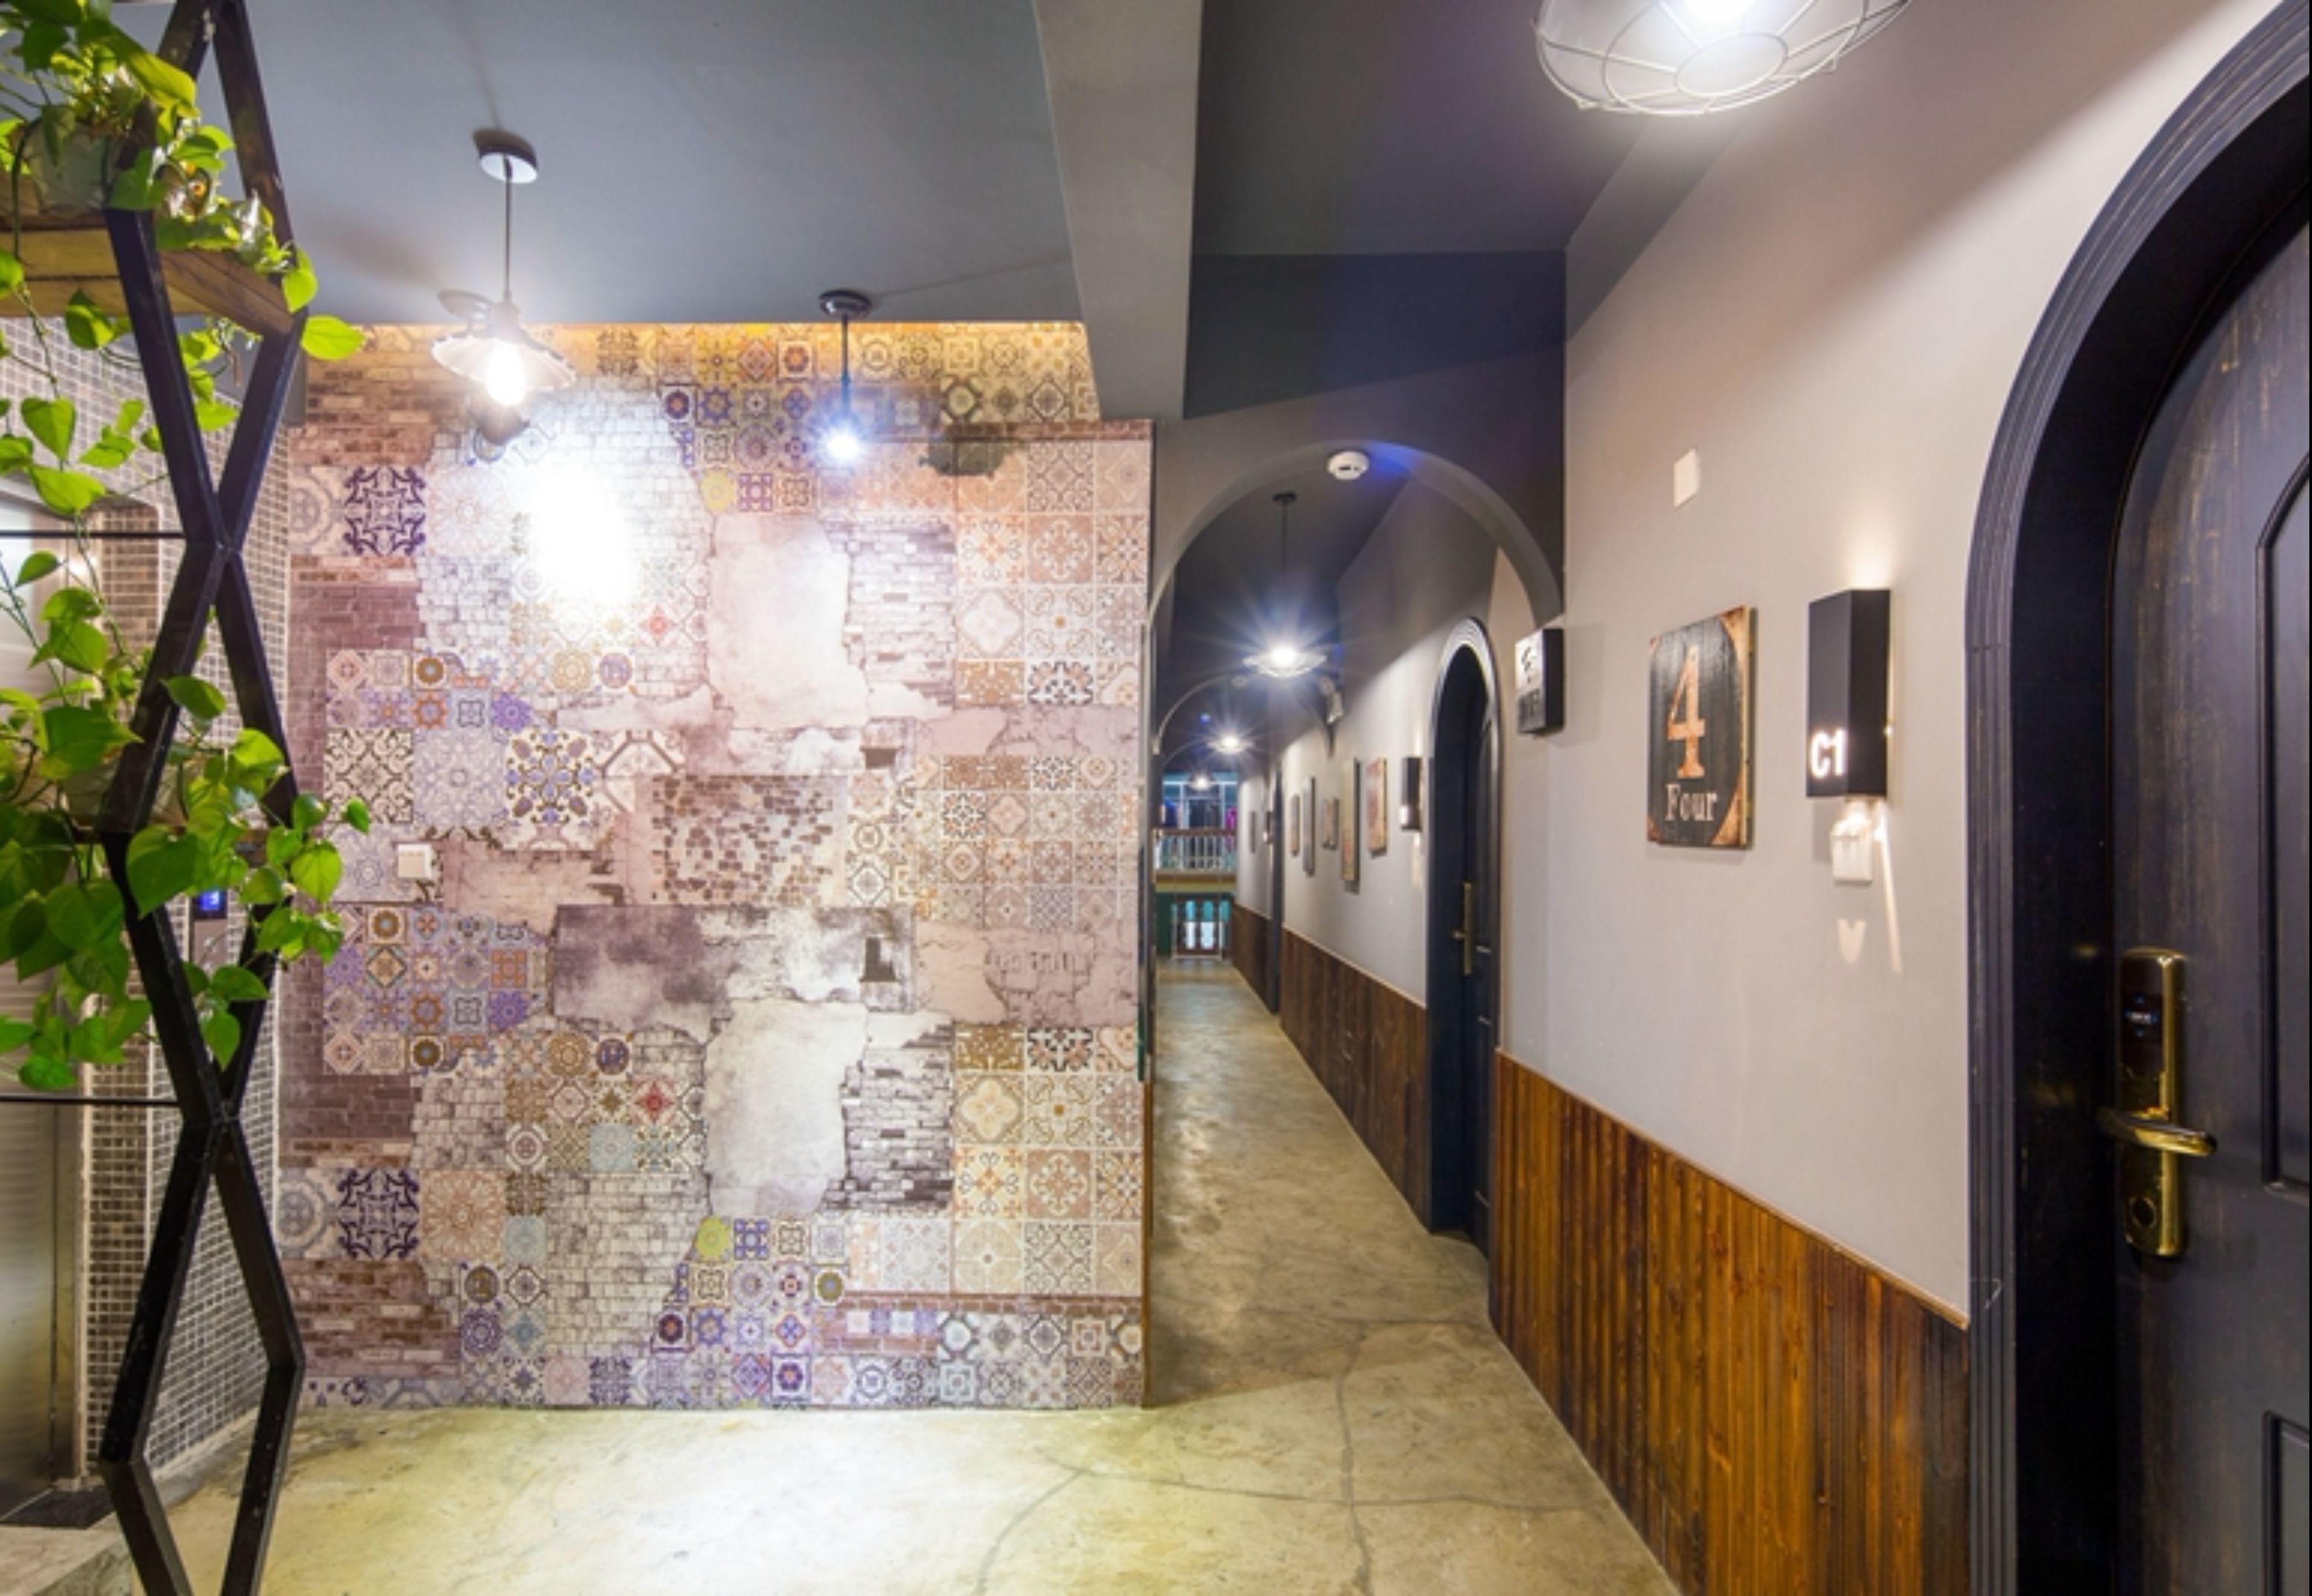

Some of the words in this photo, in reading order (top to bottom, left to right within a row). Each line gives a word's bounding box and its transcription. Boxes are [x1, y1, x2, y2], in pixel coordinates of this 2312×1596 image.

[1667, 645, 1705, 778] 4
[1810, 729, 1847, 778] C1
[1665, 783, 1718, 821] Four
